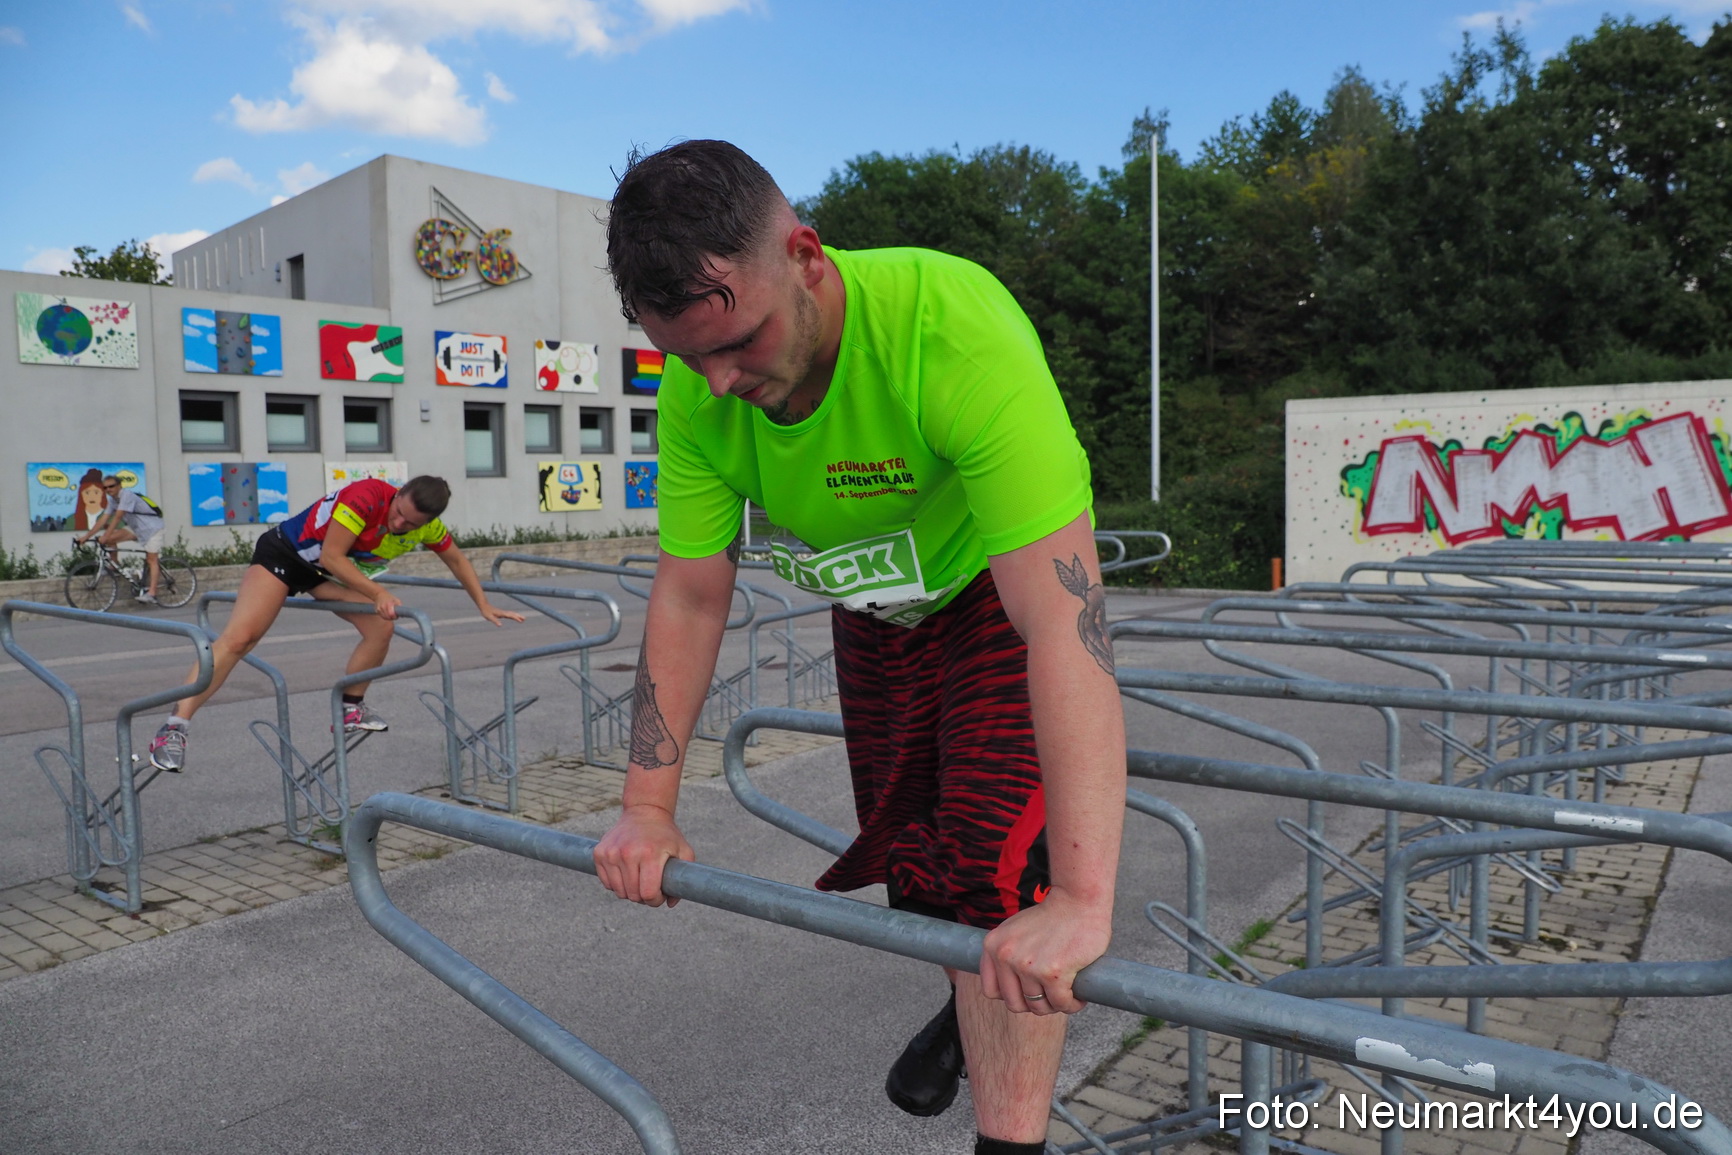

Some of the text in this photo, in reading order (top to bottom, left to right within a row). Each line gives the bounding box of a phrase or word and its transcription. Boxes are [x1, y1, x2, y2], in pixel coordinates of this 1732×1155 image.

[416, 218, 520, 286] G6
[460, 341, 485, 355] JUST
[460, 364, 485, 378] DO IT
[825, 472, 915, 488] ELEMENTELAUF
[834, 491, 849, 500] 14.
[772, 544, 904, 592] BOCK
